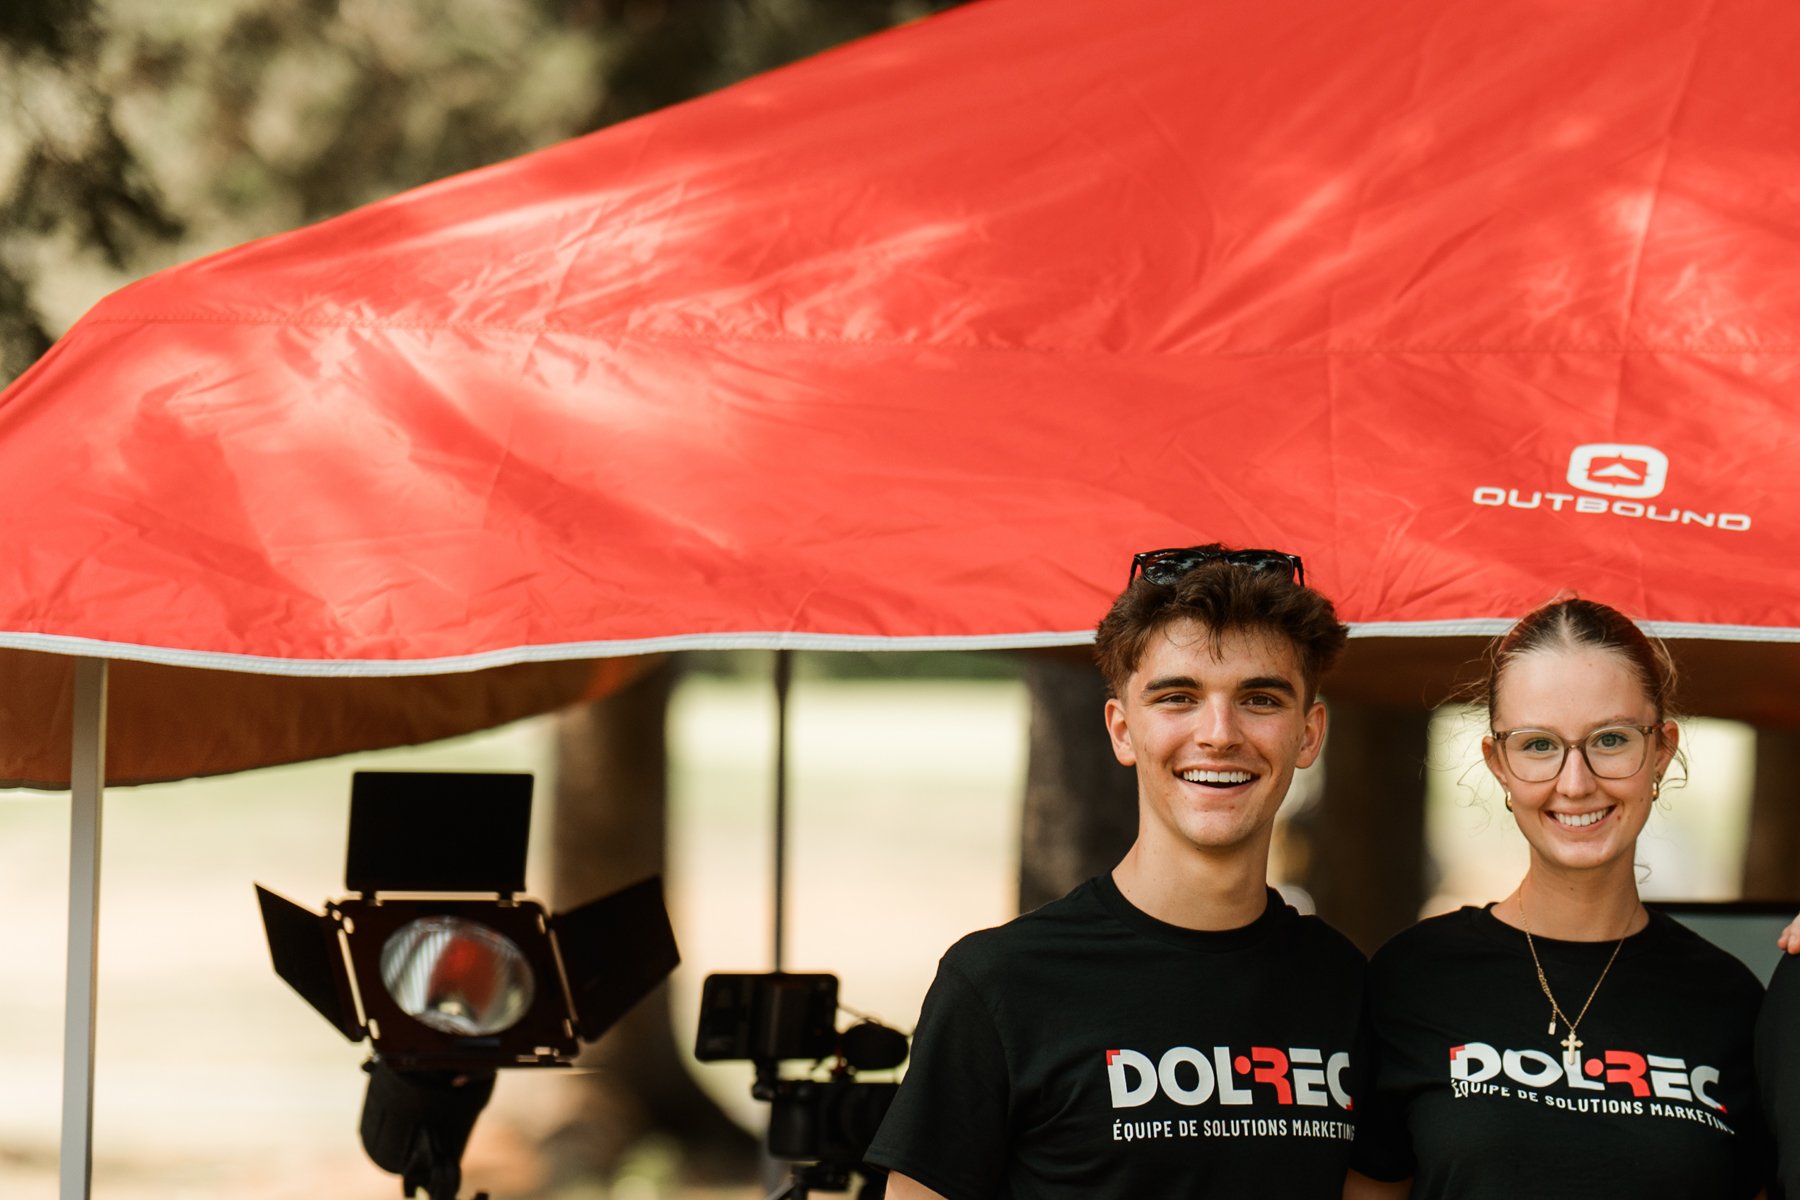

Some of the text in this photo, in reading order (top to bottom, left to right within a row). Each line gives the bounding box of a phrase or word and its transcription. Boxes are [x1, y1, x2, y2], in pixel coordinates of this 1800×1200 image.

[1472, 486, 1752, 531] OUTBOUND
[1451, 1079, 1510, 1098] ÉQUIPE
[1518, 1089, 1538, 1102] DE
[1545, 1095, 1643, 1115] SOLUTIONS
[1113, 1119, 1173, 1141] ÉQUIPE
[1179, 1119, 1197, 1137] DE
[1203, 1119, 1288, 1137] SOLUTIONS
